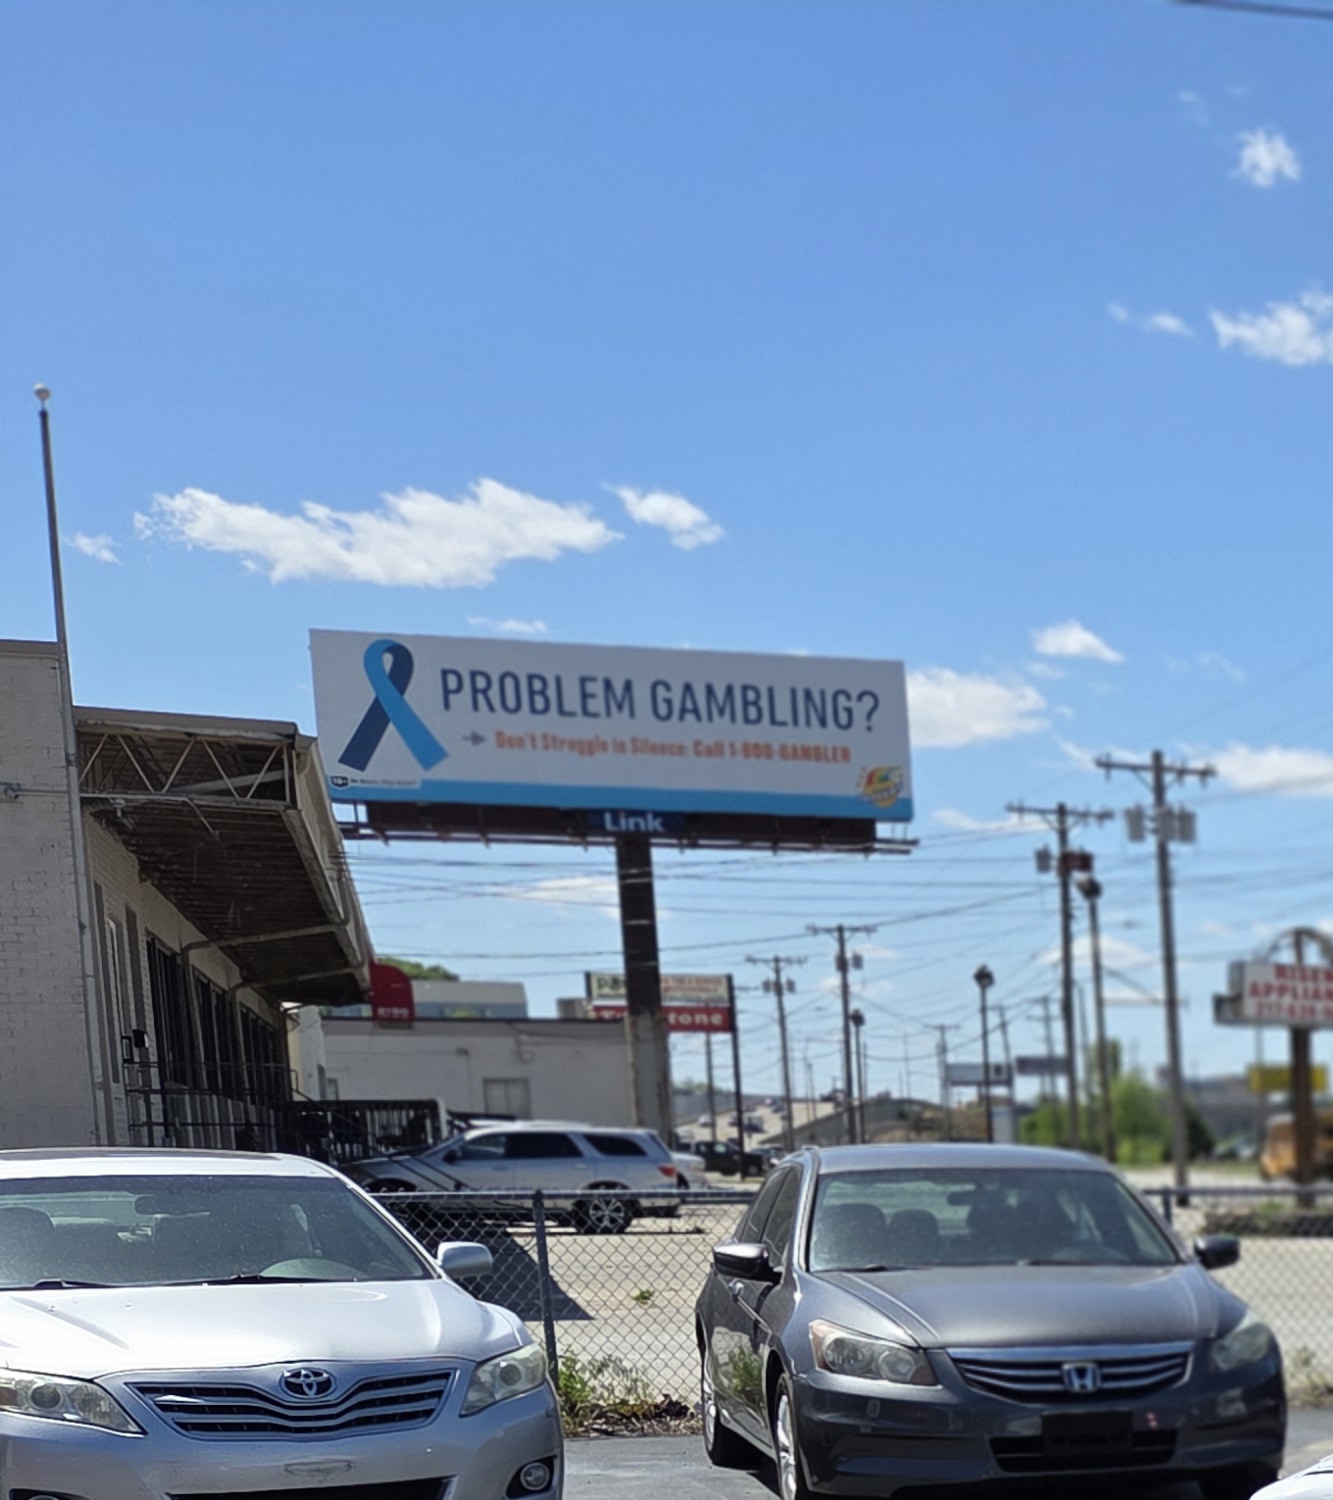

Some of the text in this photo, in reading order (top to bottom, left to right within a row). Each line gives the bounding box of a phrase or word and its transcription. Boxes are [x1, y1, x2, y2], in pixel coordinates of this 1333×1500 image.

[440, 667, 881, 733] PROBLEM GAMBLING?
[603, 811, 665, 833] Link
